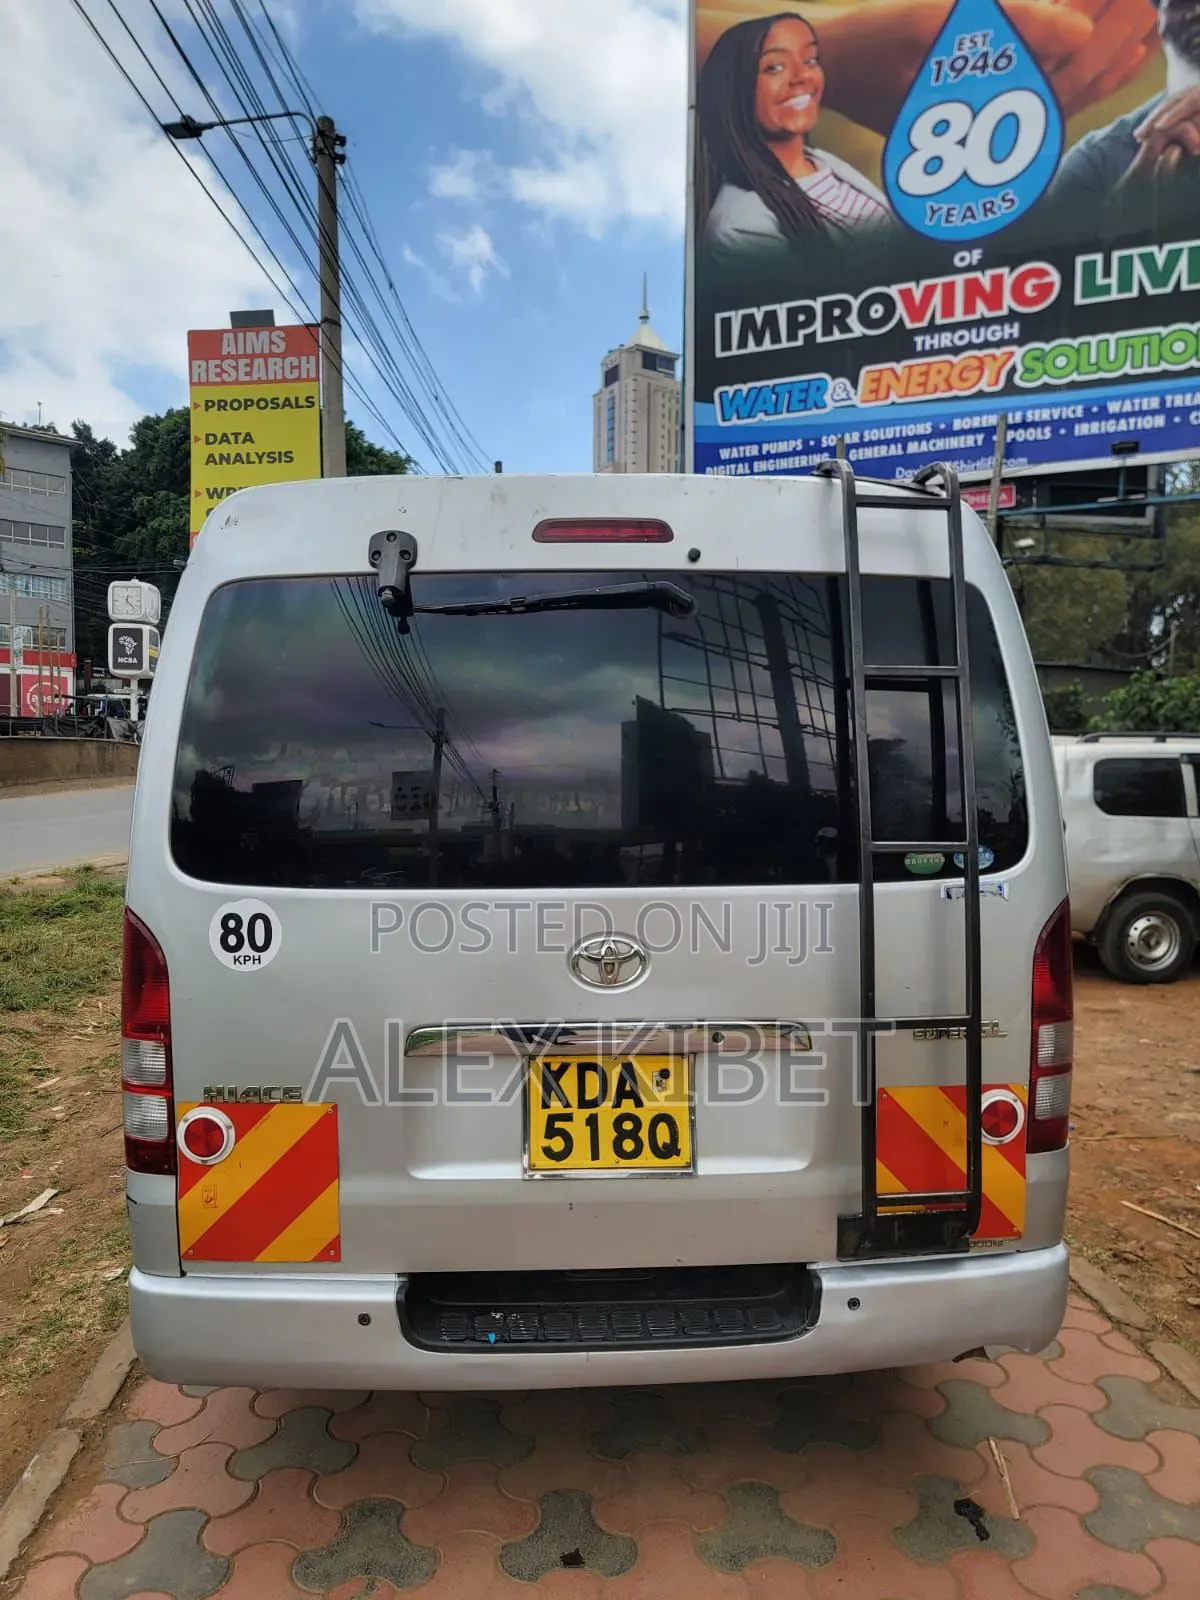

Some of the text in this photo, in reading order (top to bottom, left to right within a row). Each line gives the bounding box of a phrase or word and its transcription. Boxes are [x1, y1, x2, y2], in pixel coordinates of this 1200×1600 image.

[955, 30, 992, 52] EST
[931, 45, 1016, 84] 1946
[897, 88, 1046, 196] 80
[926, 190, 1017, 225] YEARS
[953, 249, 983, 268] OF
[716, 262, 1060, 356] IMPROVING
[221, 330, 286, 355] AIMS
[914, 322, 1019, 352] THROUGH
[192, 356, 317, 382] RESEARCH
[717, 323, 1200, 424] WATER & ENERGY SOLUTIO
[204, 396, 315, 412] PROPOSALS
[204, 432, 255, 445] DATA
[706, 462, 750, 475] DIGITAL
[849, 443, 904, 461] GENERAL
[907, 433, 984, 453] MACHINERY
[1006, 427, 1052, 442] POOLS
[1074, 414, 1166, 436] IRRIGATION
[719, 445, 758, 460] WATER
[762, 440, 803, 455] PUMPS
[821, 431, 860, 448] SOAR
[863, 422, 933, 442] SOLUTIONS
[952, 411, 1022, 431] BOREHLE
[1025, 405, 1084, 423] SERVICE
[1106, 397, 1161, 414] WATER
[204, 451, 295, 465] ANALYSIS
[219, 912, 273, 954] 80
[233, 954, 262, 966] KPH
[203, 1085, 303, 1103] HIACE
[541, 1061, 644, 1110] KDA
[541, 1112, 681, 1162] 518Q
